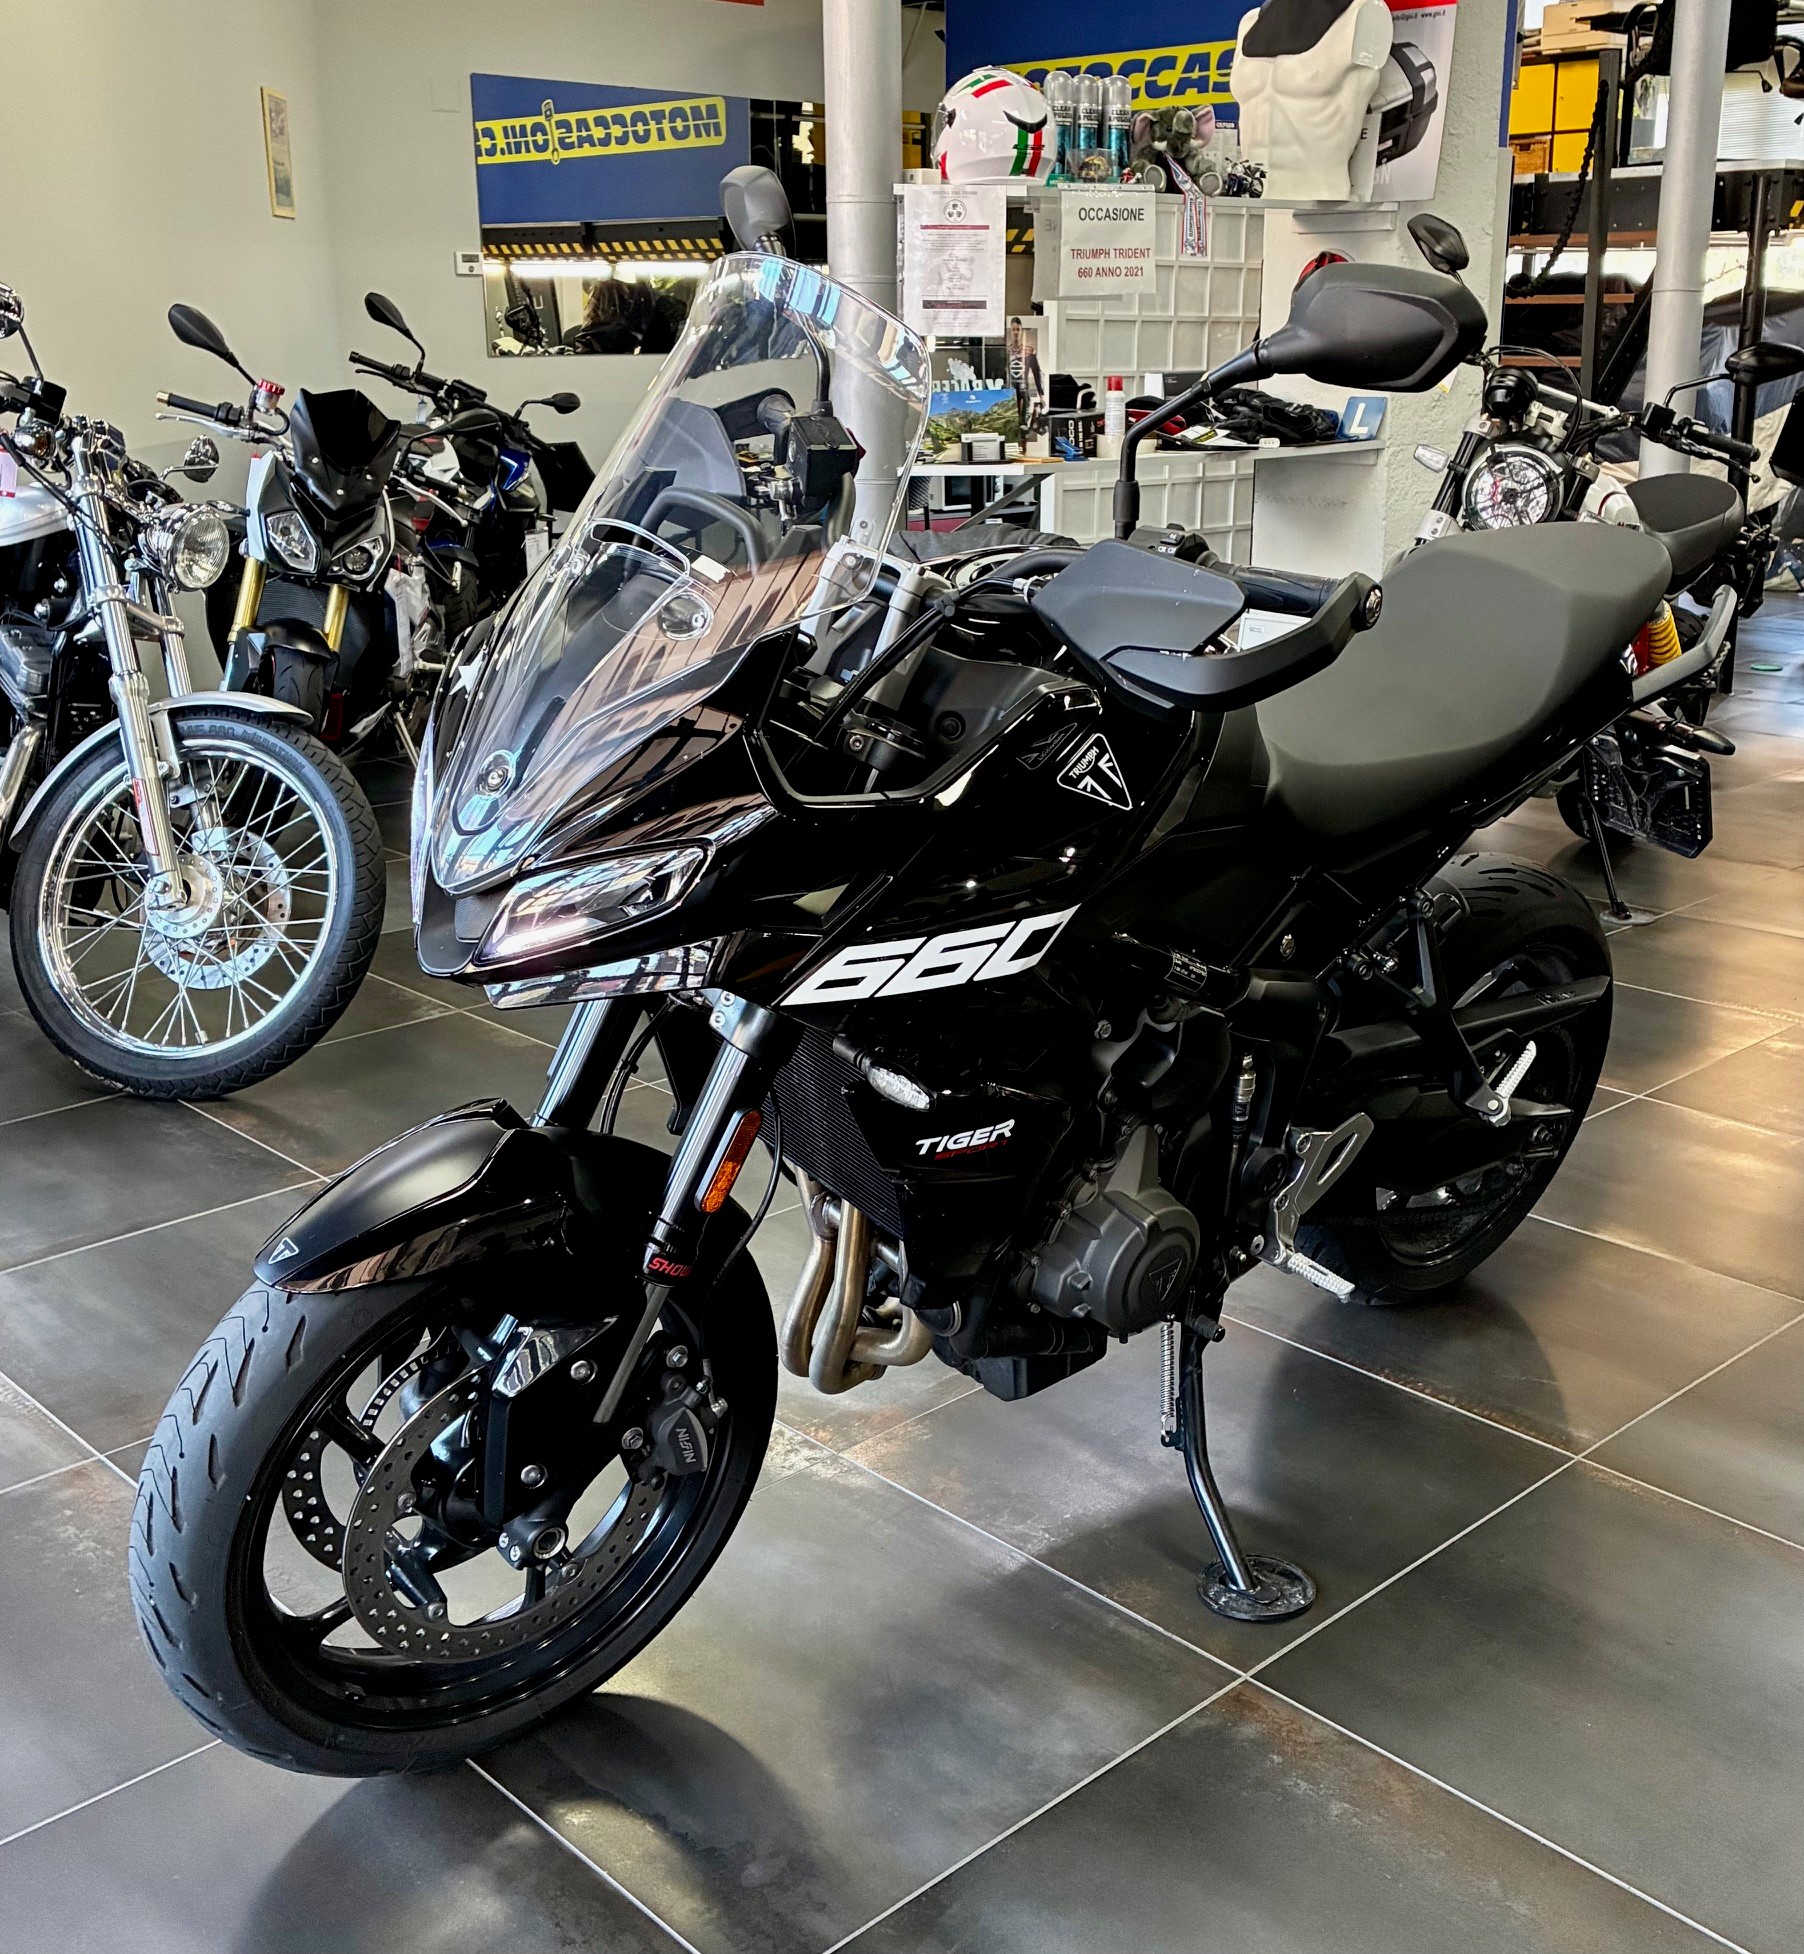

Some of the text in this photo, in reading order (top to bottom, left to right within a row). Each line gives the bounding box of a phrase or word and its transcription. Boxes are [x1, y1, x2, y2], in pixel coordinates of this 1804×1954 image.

[1078, 207, 1145, 222] OCCASIONE
[1071, 248, 1151, 260] TRIUMPH TRIDENT
[1077, 266, 1144, 278] 660 ANNO 2021
[1350, 403, 1369, 434] L
[1068, 745, 1100, 779] TRIUMPH
[779, 902, 1082, 1007] 660
[915, 1118, 1016, 1156] TIGER
[675, 1427, 697, 1464] NISSIN
